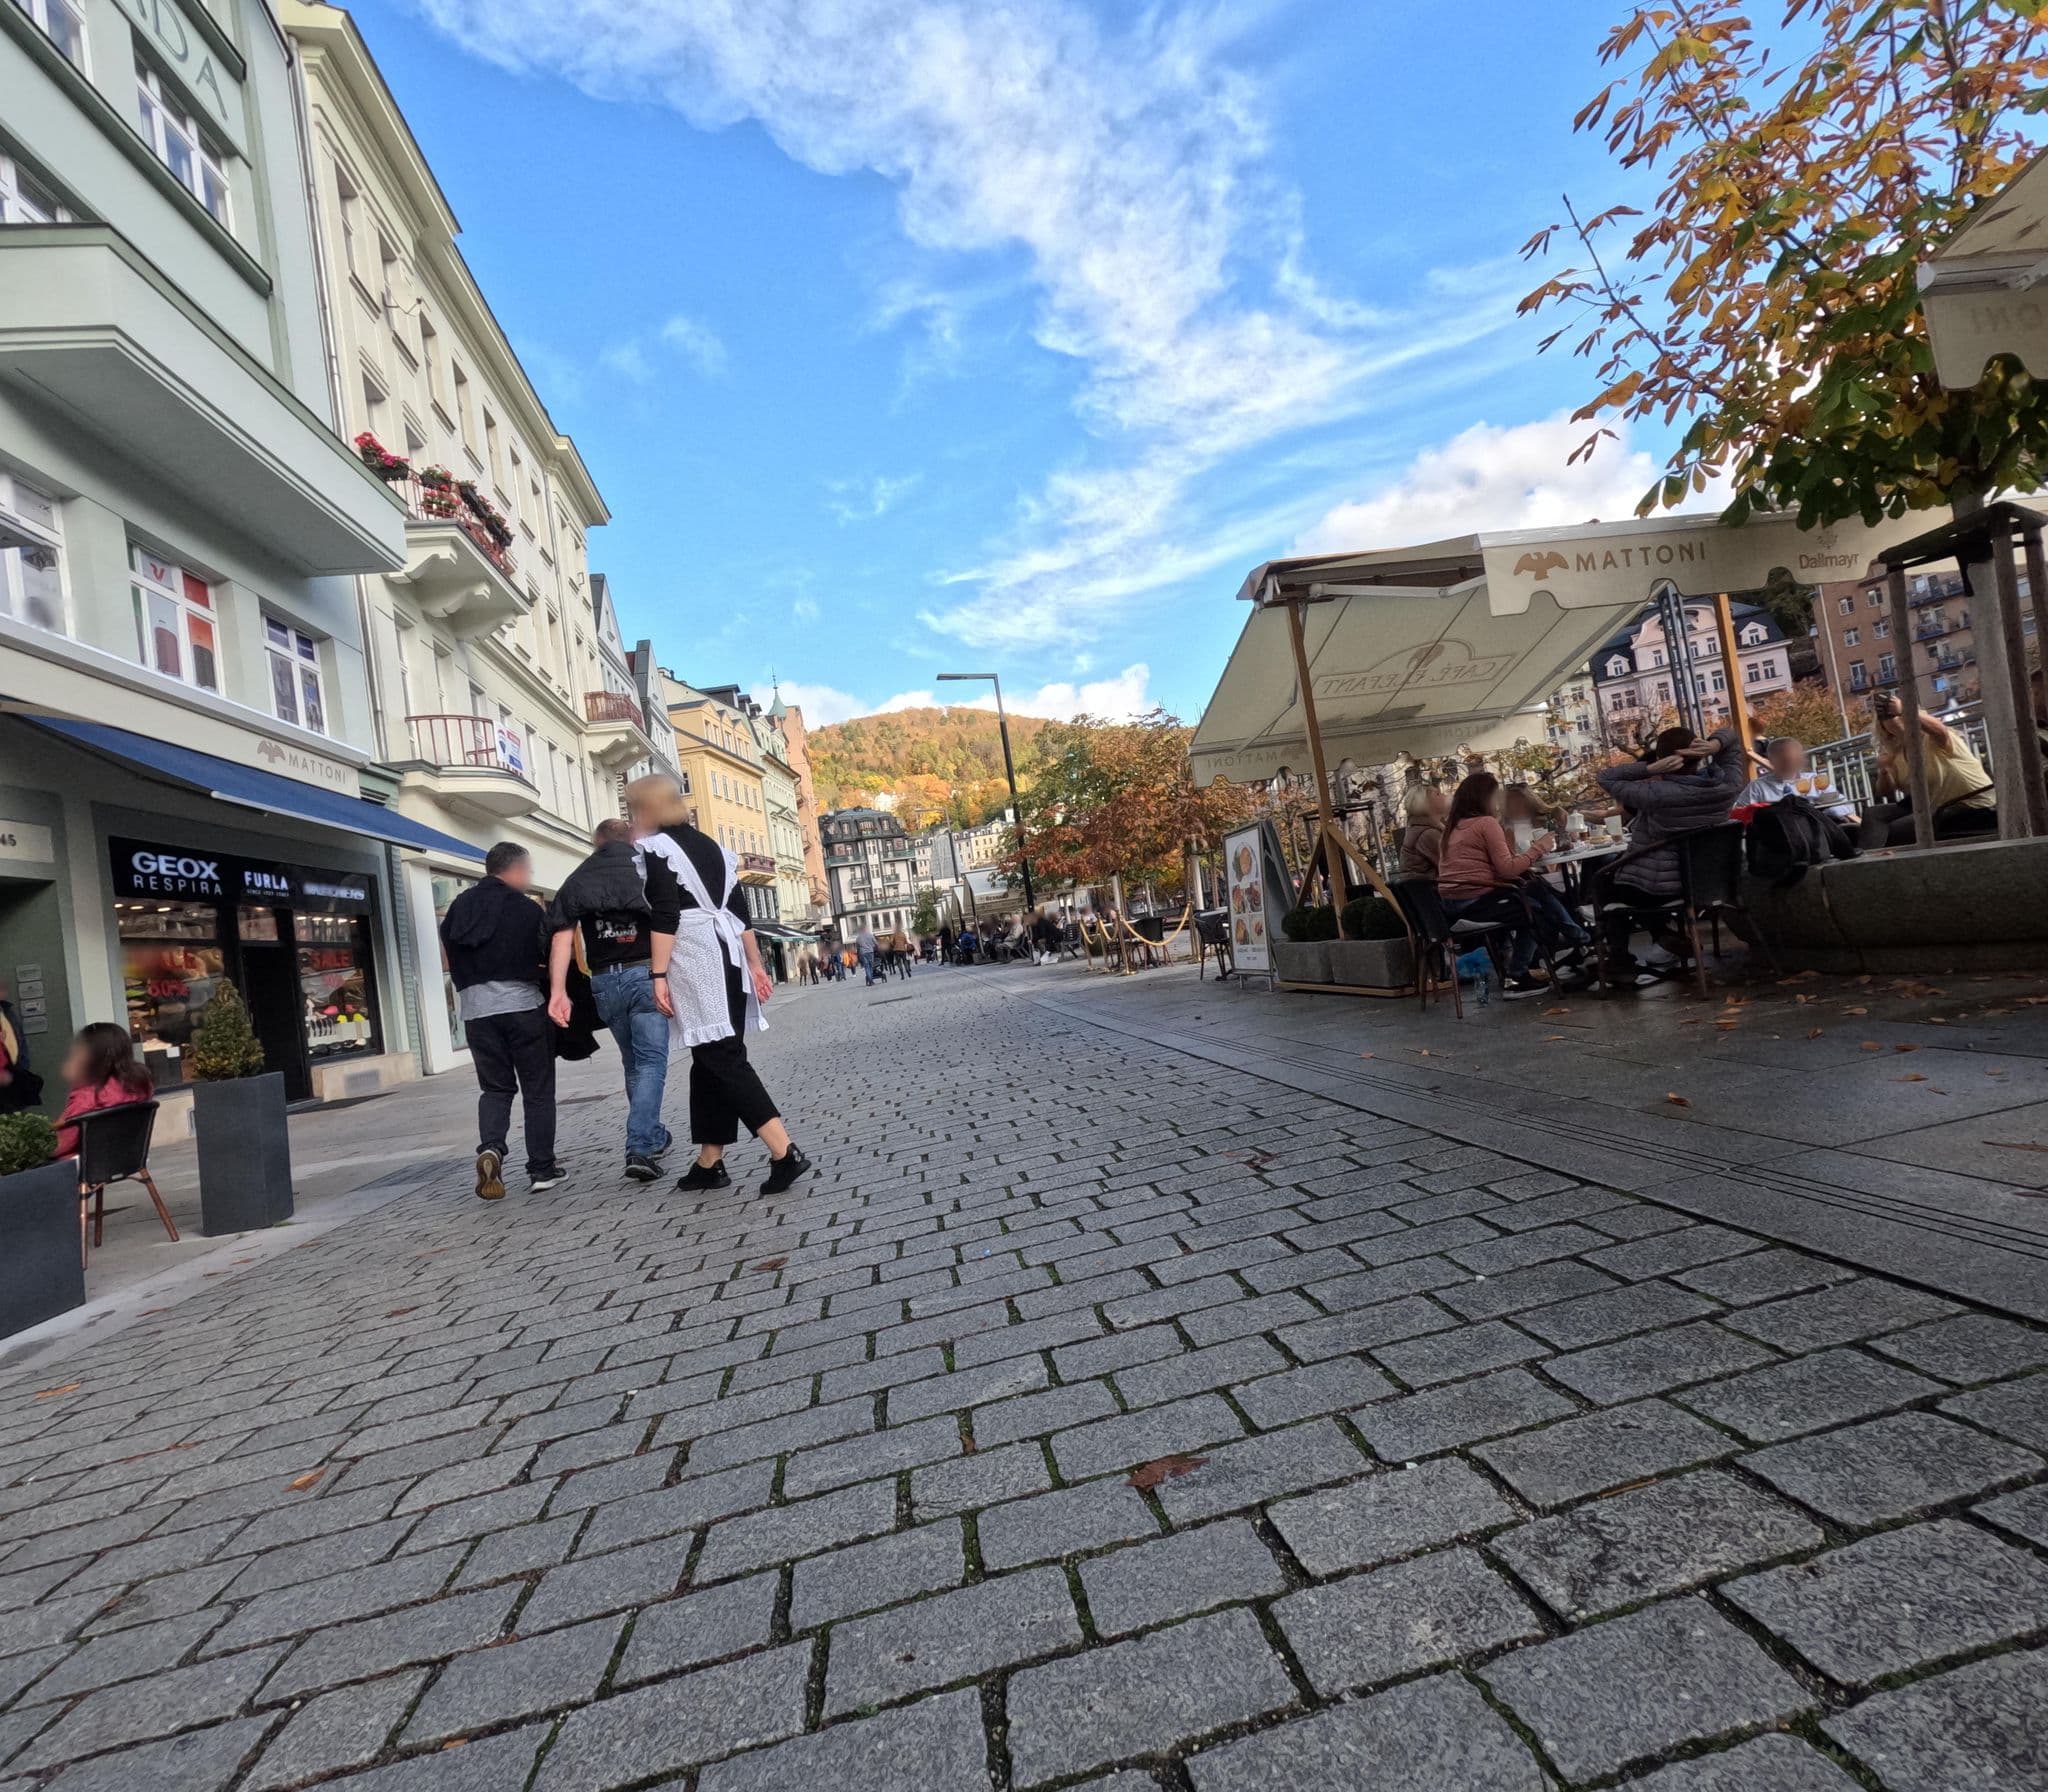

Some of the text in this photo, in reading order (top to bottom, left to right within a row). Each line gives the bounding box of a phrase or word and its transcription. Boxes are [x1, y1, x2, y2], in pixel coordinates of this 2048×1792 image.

[1576, 541, 1706, 572] MATTONI
[1798, 553, 1860, 569] Dallmayr
[288, 752, 346, 784] MATTONI
[131, 851, 220, 880] GEOX
[133, 874, 223, 896] RESPIRA
[244, 871, 289, 890] FURLA
[311, 950, 352, 970] SALE
